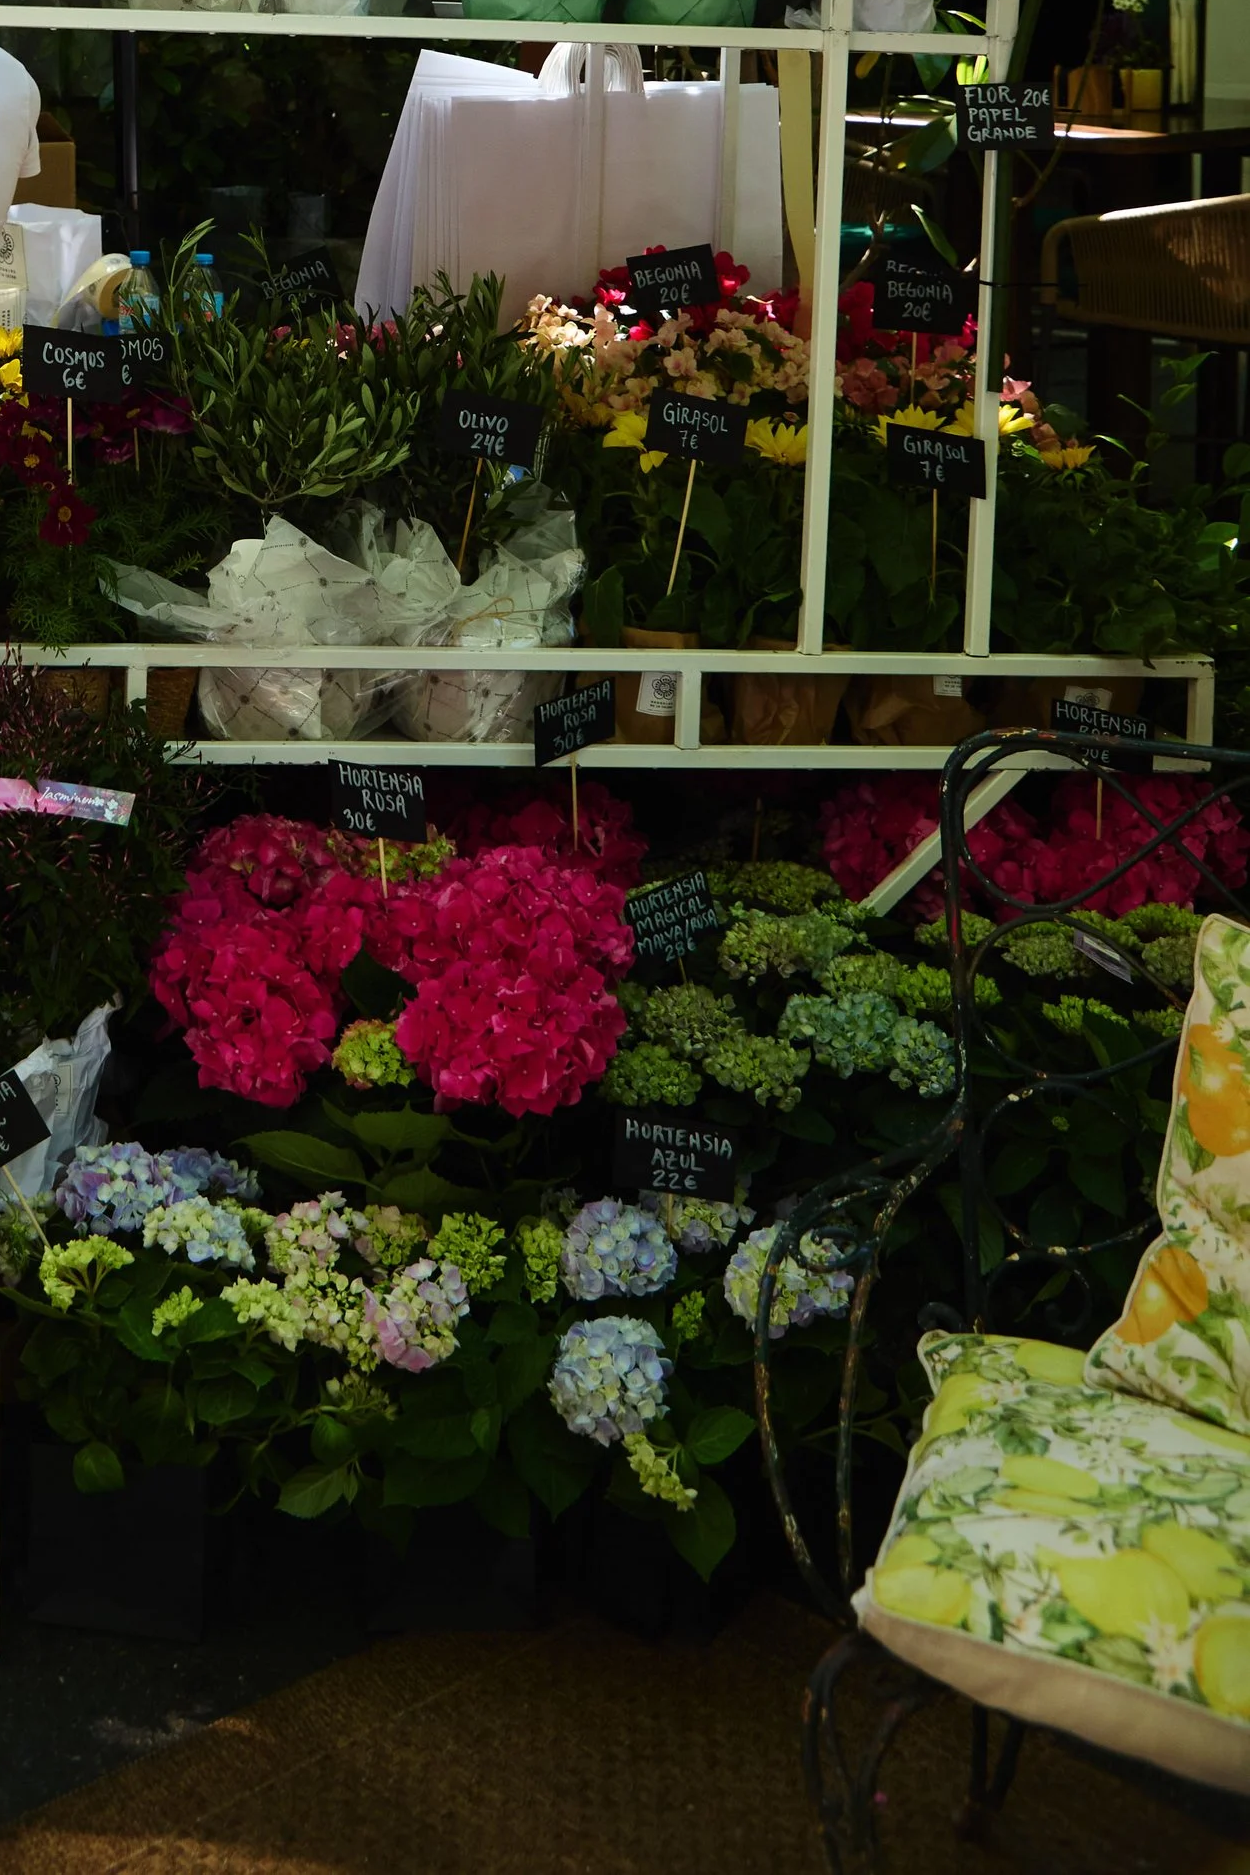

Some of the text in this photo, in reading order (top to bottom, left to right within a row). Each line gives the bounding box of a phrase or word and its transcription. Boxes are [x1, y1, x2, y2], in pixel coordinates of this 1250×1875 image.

[964, 86, 1050, 108] FLOR 20€
[968, 106, 1028, 129] PAPEL
[967, 125, 1038, 143] GRANDE
[659, 283, 691, 305] 20€
[902, 302, 932, 322] 20€
[42, 342, 105, 372] COSMOS
[62, 368, 87, 391] 6€
[470, 433, 505, 456] 24€
[563, 704, 597, 732] ROSA
[552, 728, 585, 757] 30€
[362, 789, 408, 819] ROSA
[343, 808, 376, 832] 30€
[629, 870, 707, 919] HORTENSIA
[636, 896, 706, 934] MAGICAL
[665, 937, 696, 962] 28€
[651, 1147, 706, 1172] AZUL
[652, 1169, 697, 1190] 22€
